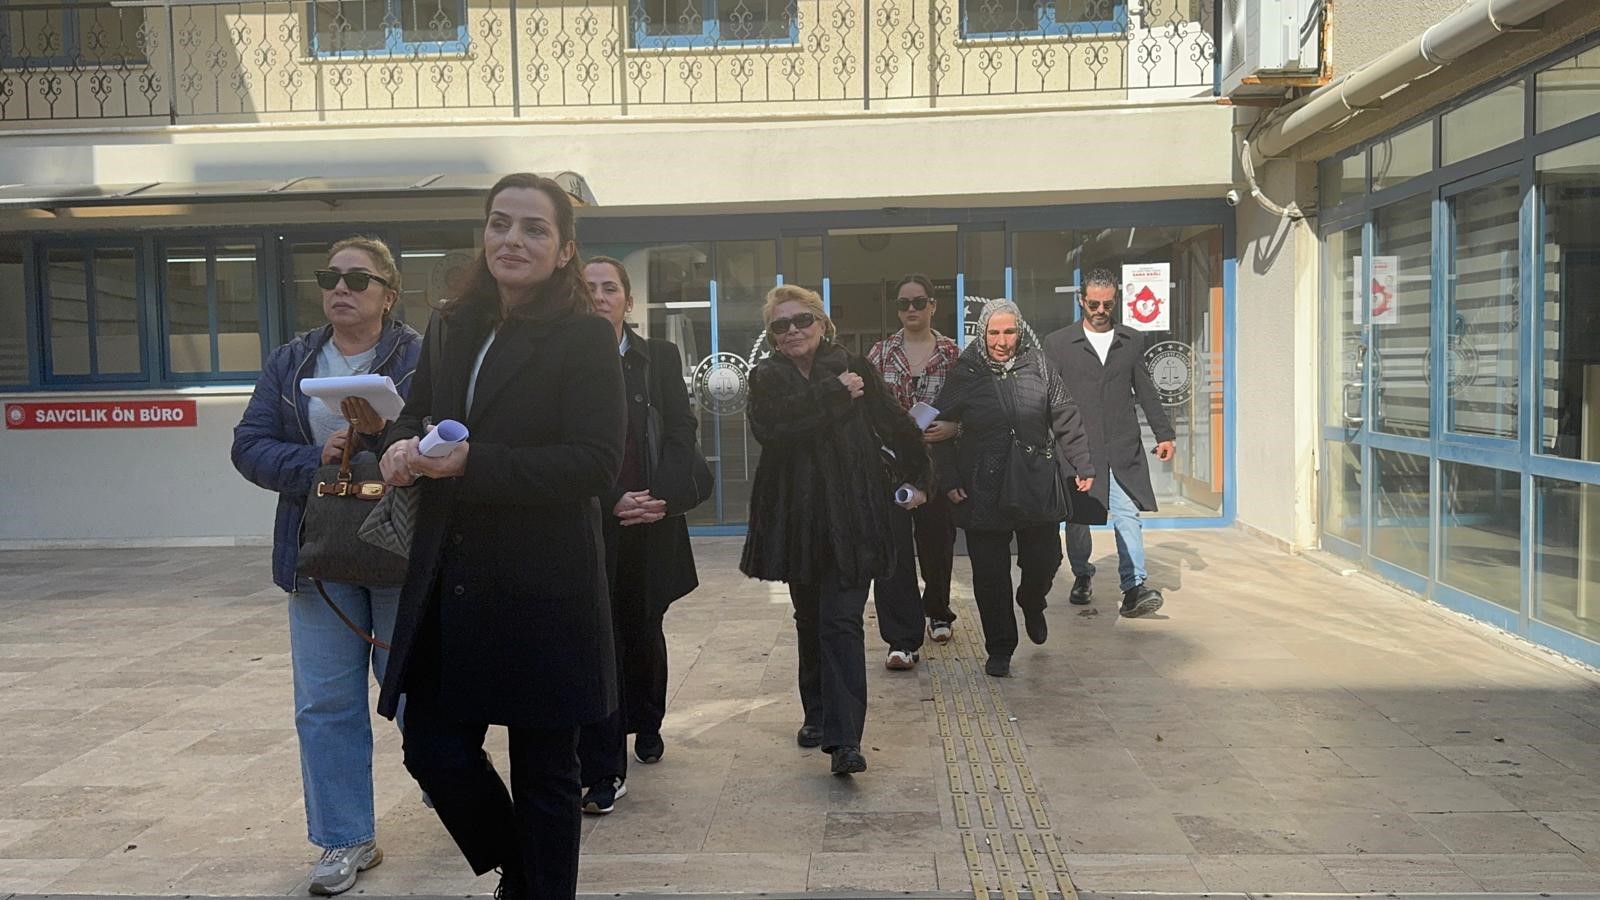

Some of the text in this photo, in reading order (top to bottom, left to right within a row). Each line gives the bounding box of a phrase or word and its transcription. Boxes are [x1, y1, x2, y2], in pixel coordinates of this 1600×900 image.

[35, 409, 108, 423] SAVCILIK
[112, 406, 135, 422] ÖN
[140, 406, 184, 422] BÜRO
